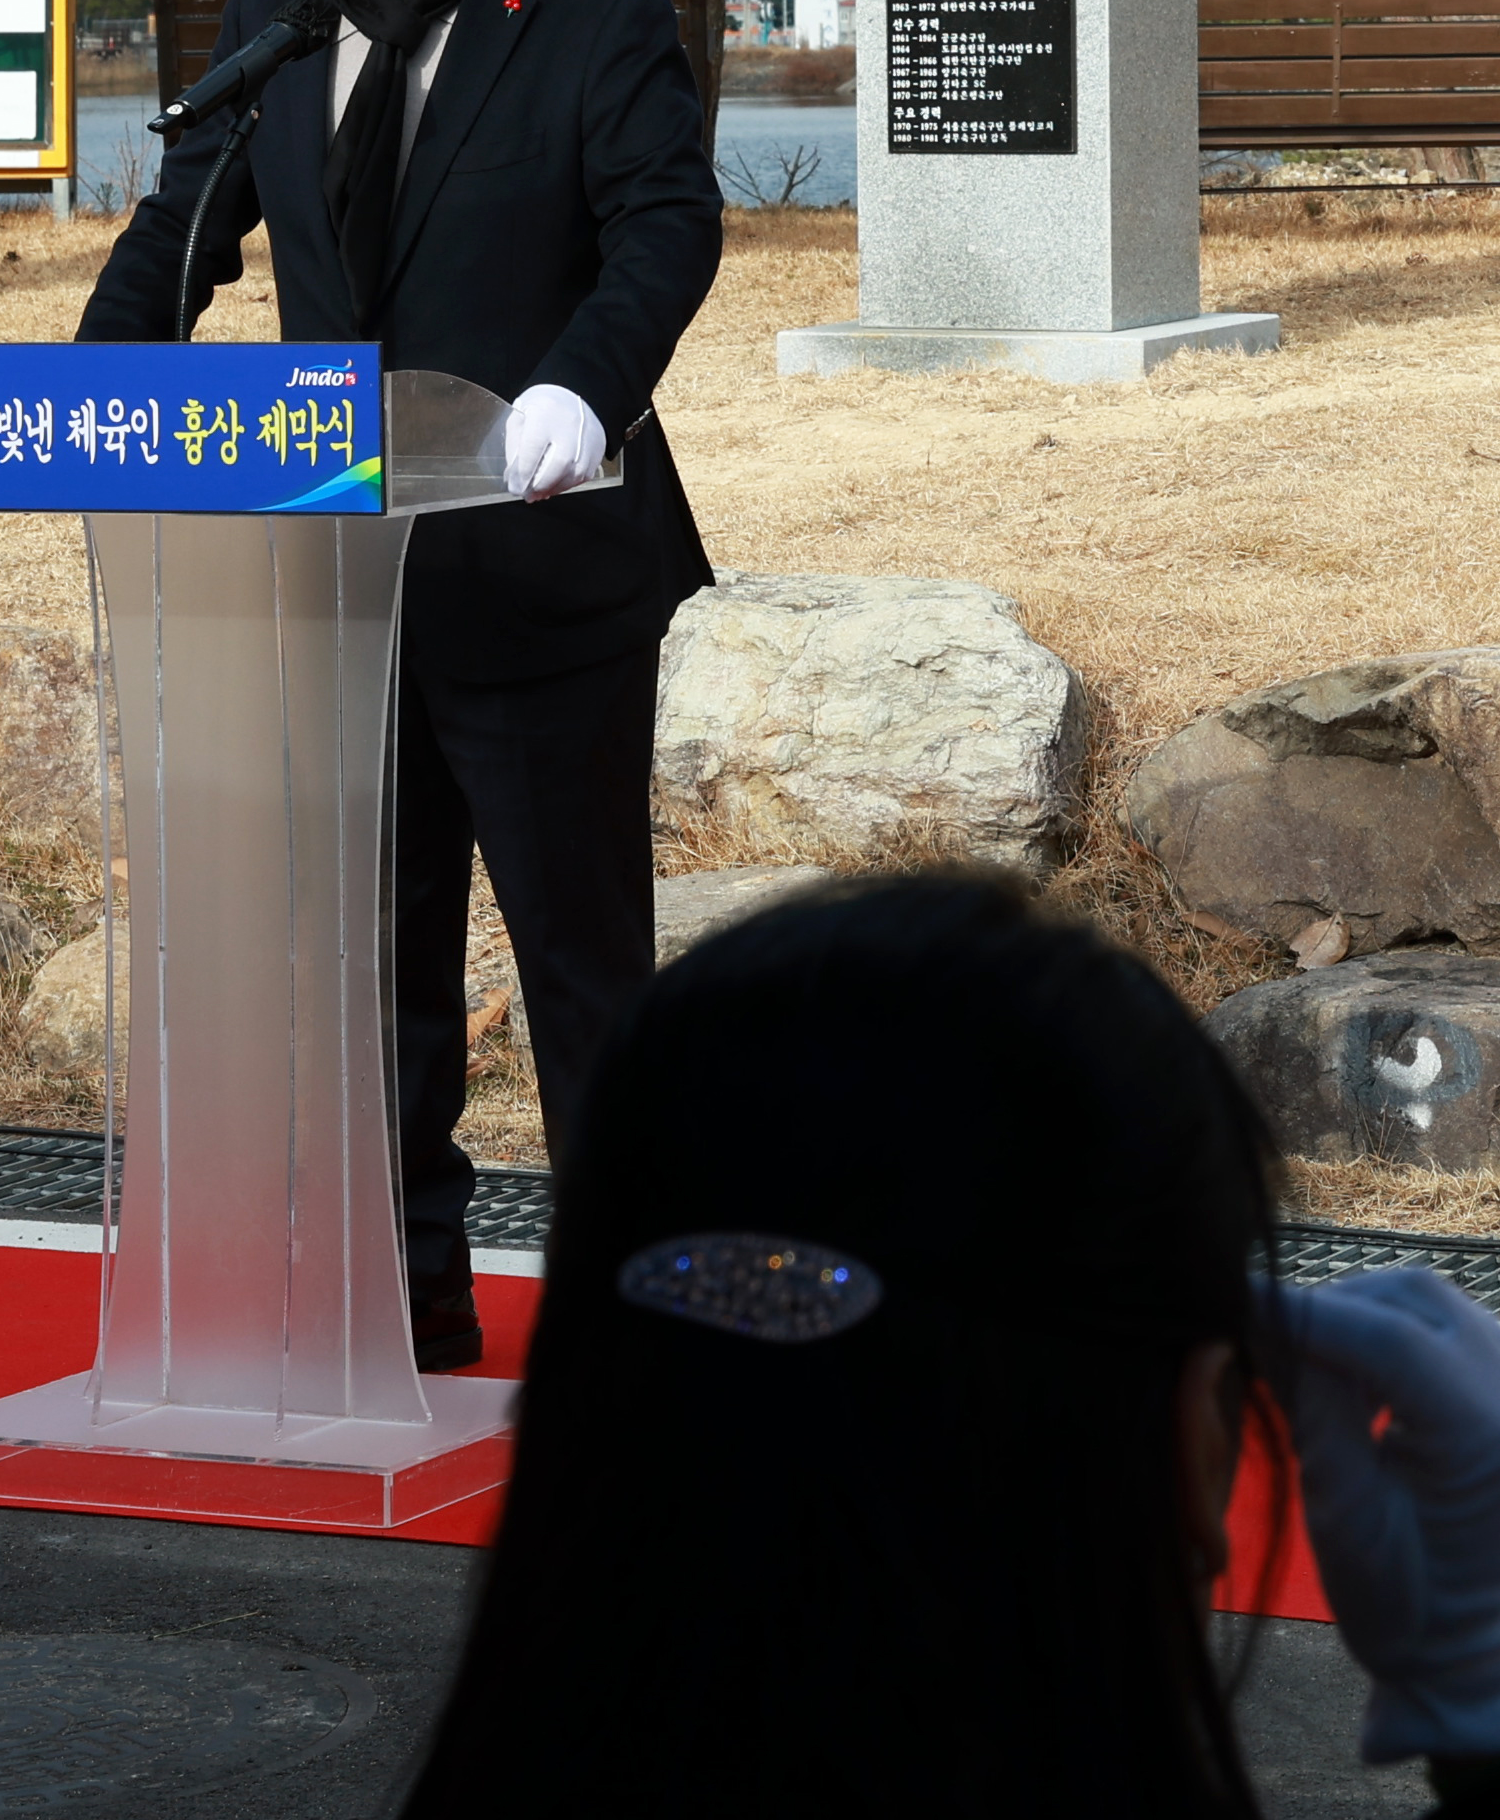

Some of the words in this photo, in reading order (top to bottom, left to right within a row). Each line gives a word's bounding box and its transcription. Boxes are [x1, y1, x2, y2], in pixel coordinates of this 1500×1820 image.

[893, 18, 914, 31] 선수
[918, 18, 939, 31] 경력
[893, 45, 910, 53] 1964
[894, 107, 916, 119] 주요
[920, 106, 941, 120] 경력
[285, 367, 345, 388] Jindo
[66, 398, 158, 464] 체육인
[174, 399, 244, 465] 흉상
[257, 399, 352, 466] 제막식
